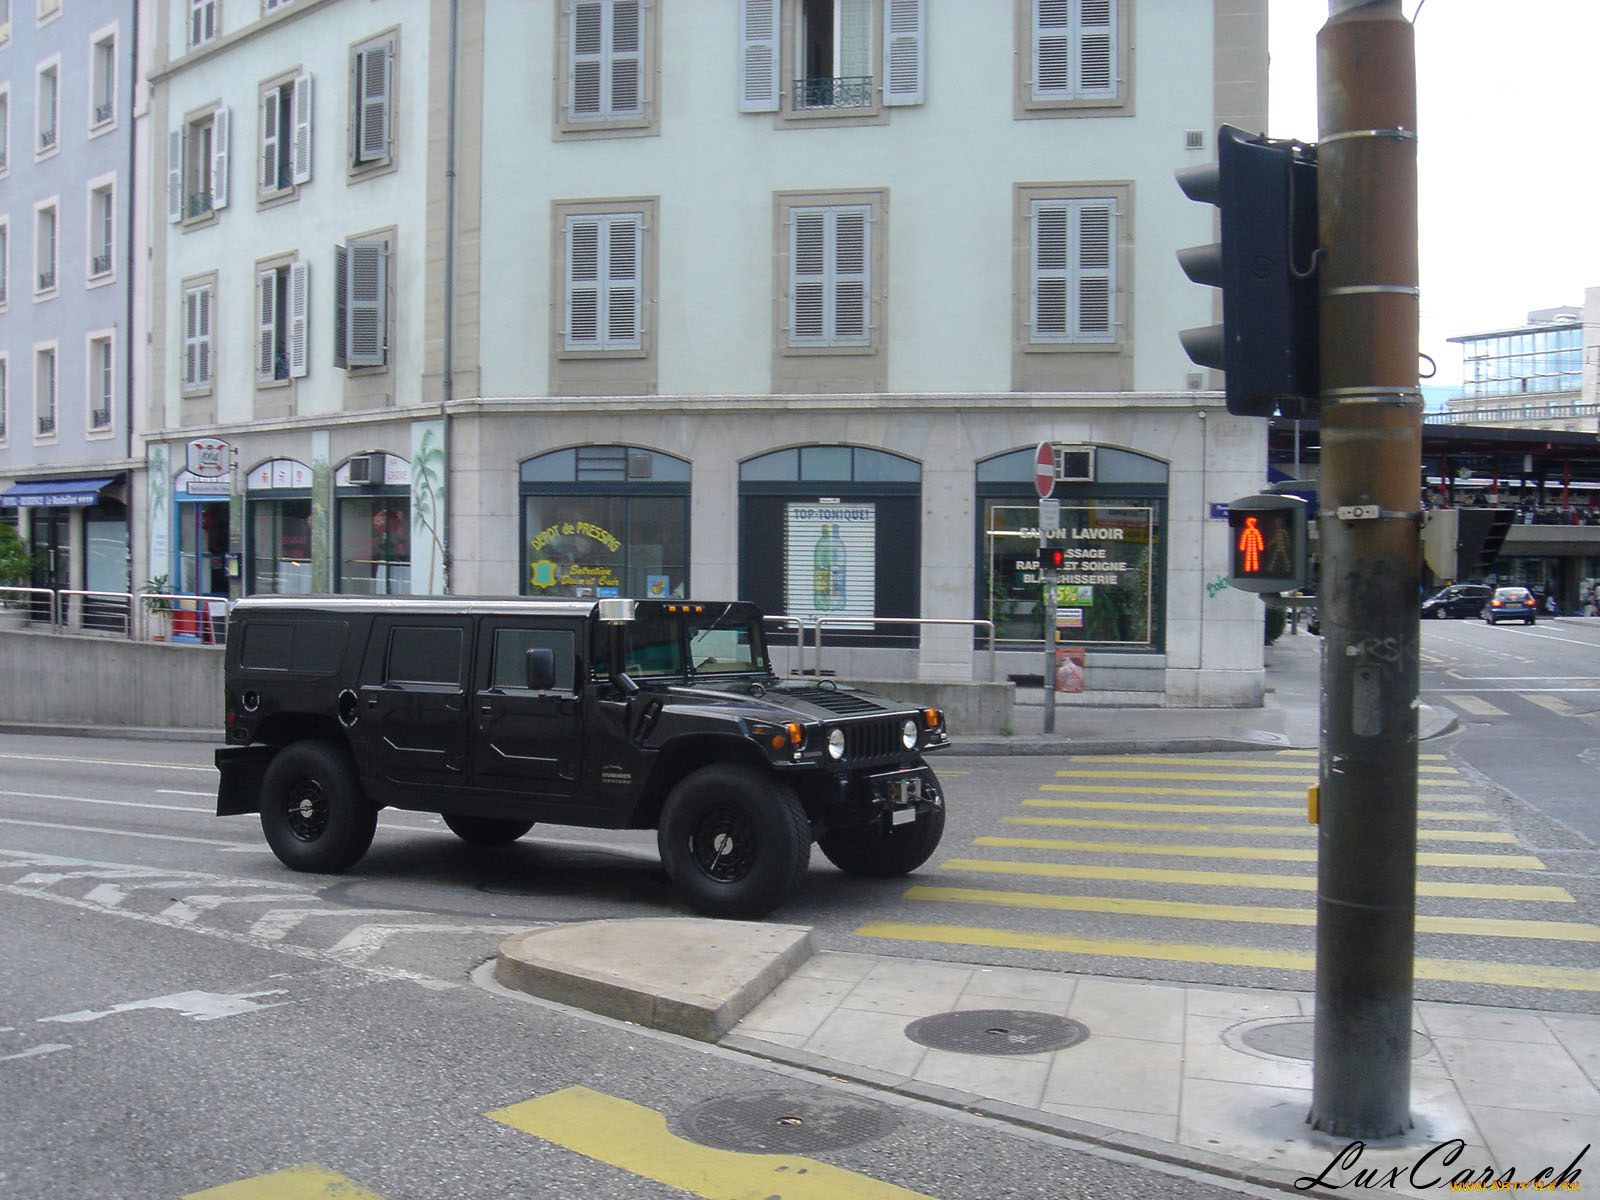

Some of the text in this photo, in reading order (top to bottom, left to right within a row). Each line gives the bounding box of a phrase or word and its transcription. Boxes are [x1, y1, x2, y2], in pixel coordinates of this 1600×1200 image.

[794, 508, 869, 522] TOP-TONIQUE!
[562, 522, 575, 535] de
[576, 521, 621, 552] PRESSING
[1019, 527, 1124, 540] SAON LAVOIR
[1063, 561, 1079, 571] ET
[1081, 561, 1127, 571] SOIGNE
